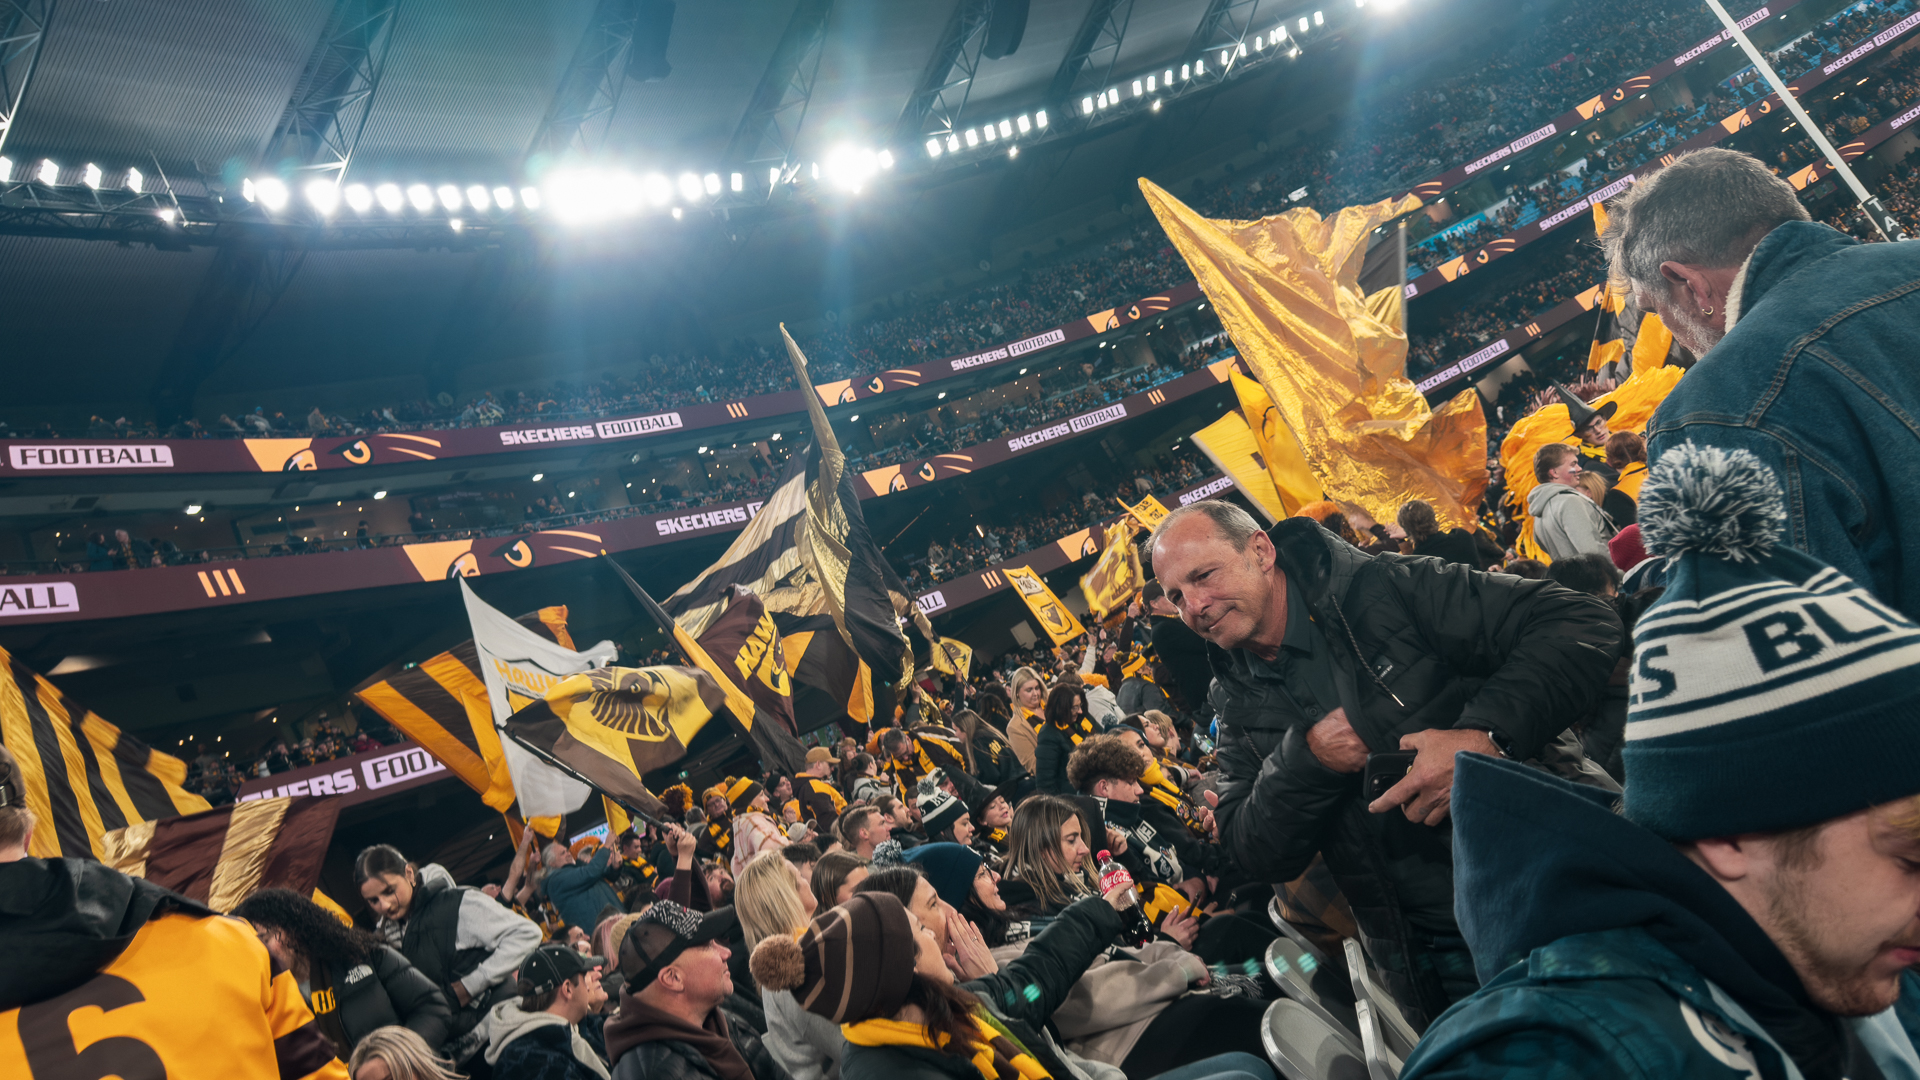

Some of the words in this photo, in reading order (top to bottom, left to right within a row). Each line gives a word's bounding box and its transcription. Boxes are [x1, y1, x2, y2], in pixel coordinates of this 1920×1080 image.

[1674, 34, 1722, 67] SKECHERS
[1725, 10, 1767, 38] FTBALL
[1823, 40, 1875, 76] SKECHERS
[1877, 14, 1920, 44] FOOTBALL
[1464, 145, 1512, 175] SKECHERS
[1513, 126, 1554, 150] FOOTBALL
[1539, 198, 1590, 231] SKECHERS
[951, 347, 1008, 371] SKECHERS
[1011, 332, 1062, 354] FOOTBALL
[1462, 342, 1506, 370] FOOTBALL
[500, 425, 595, 446] SKECHERS
[602, 415, 679, 436] FOOTBALL
[1007, 422, 1070, 452] SKECHERS
[1073, 406, 1124, 430] FOOTBALL
[20, 448, 167, 466] FOOTBALL
[1179, 475, 1234, 507] SKECHERS
[656, 506, 747, 535] SKECHERS
